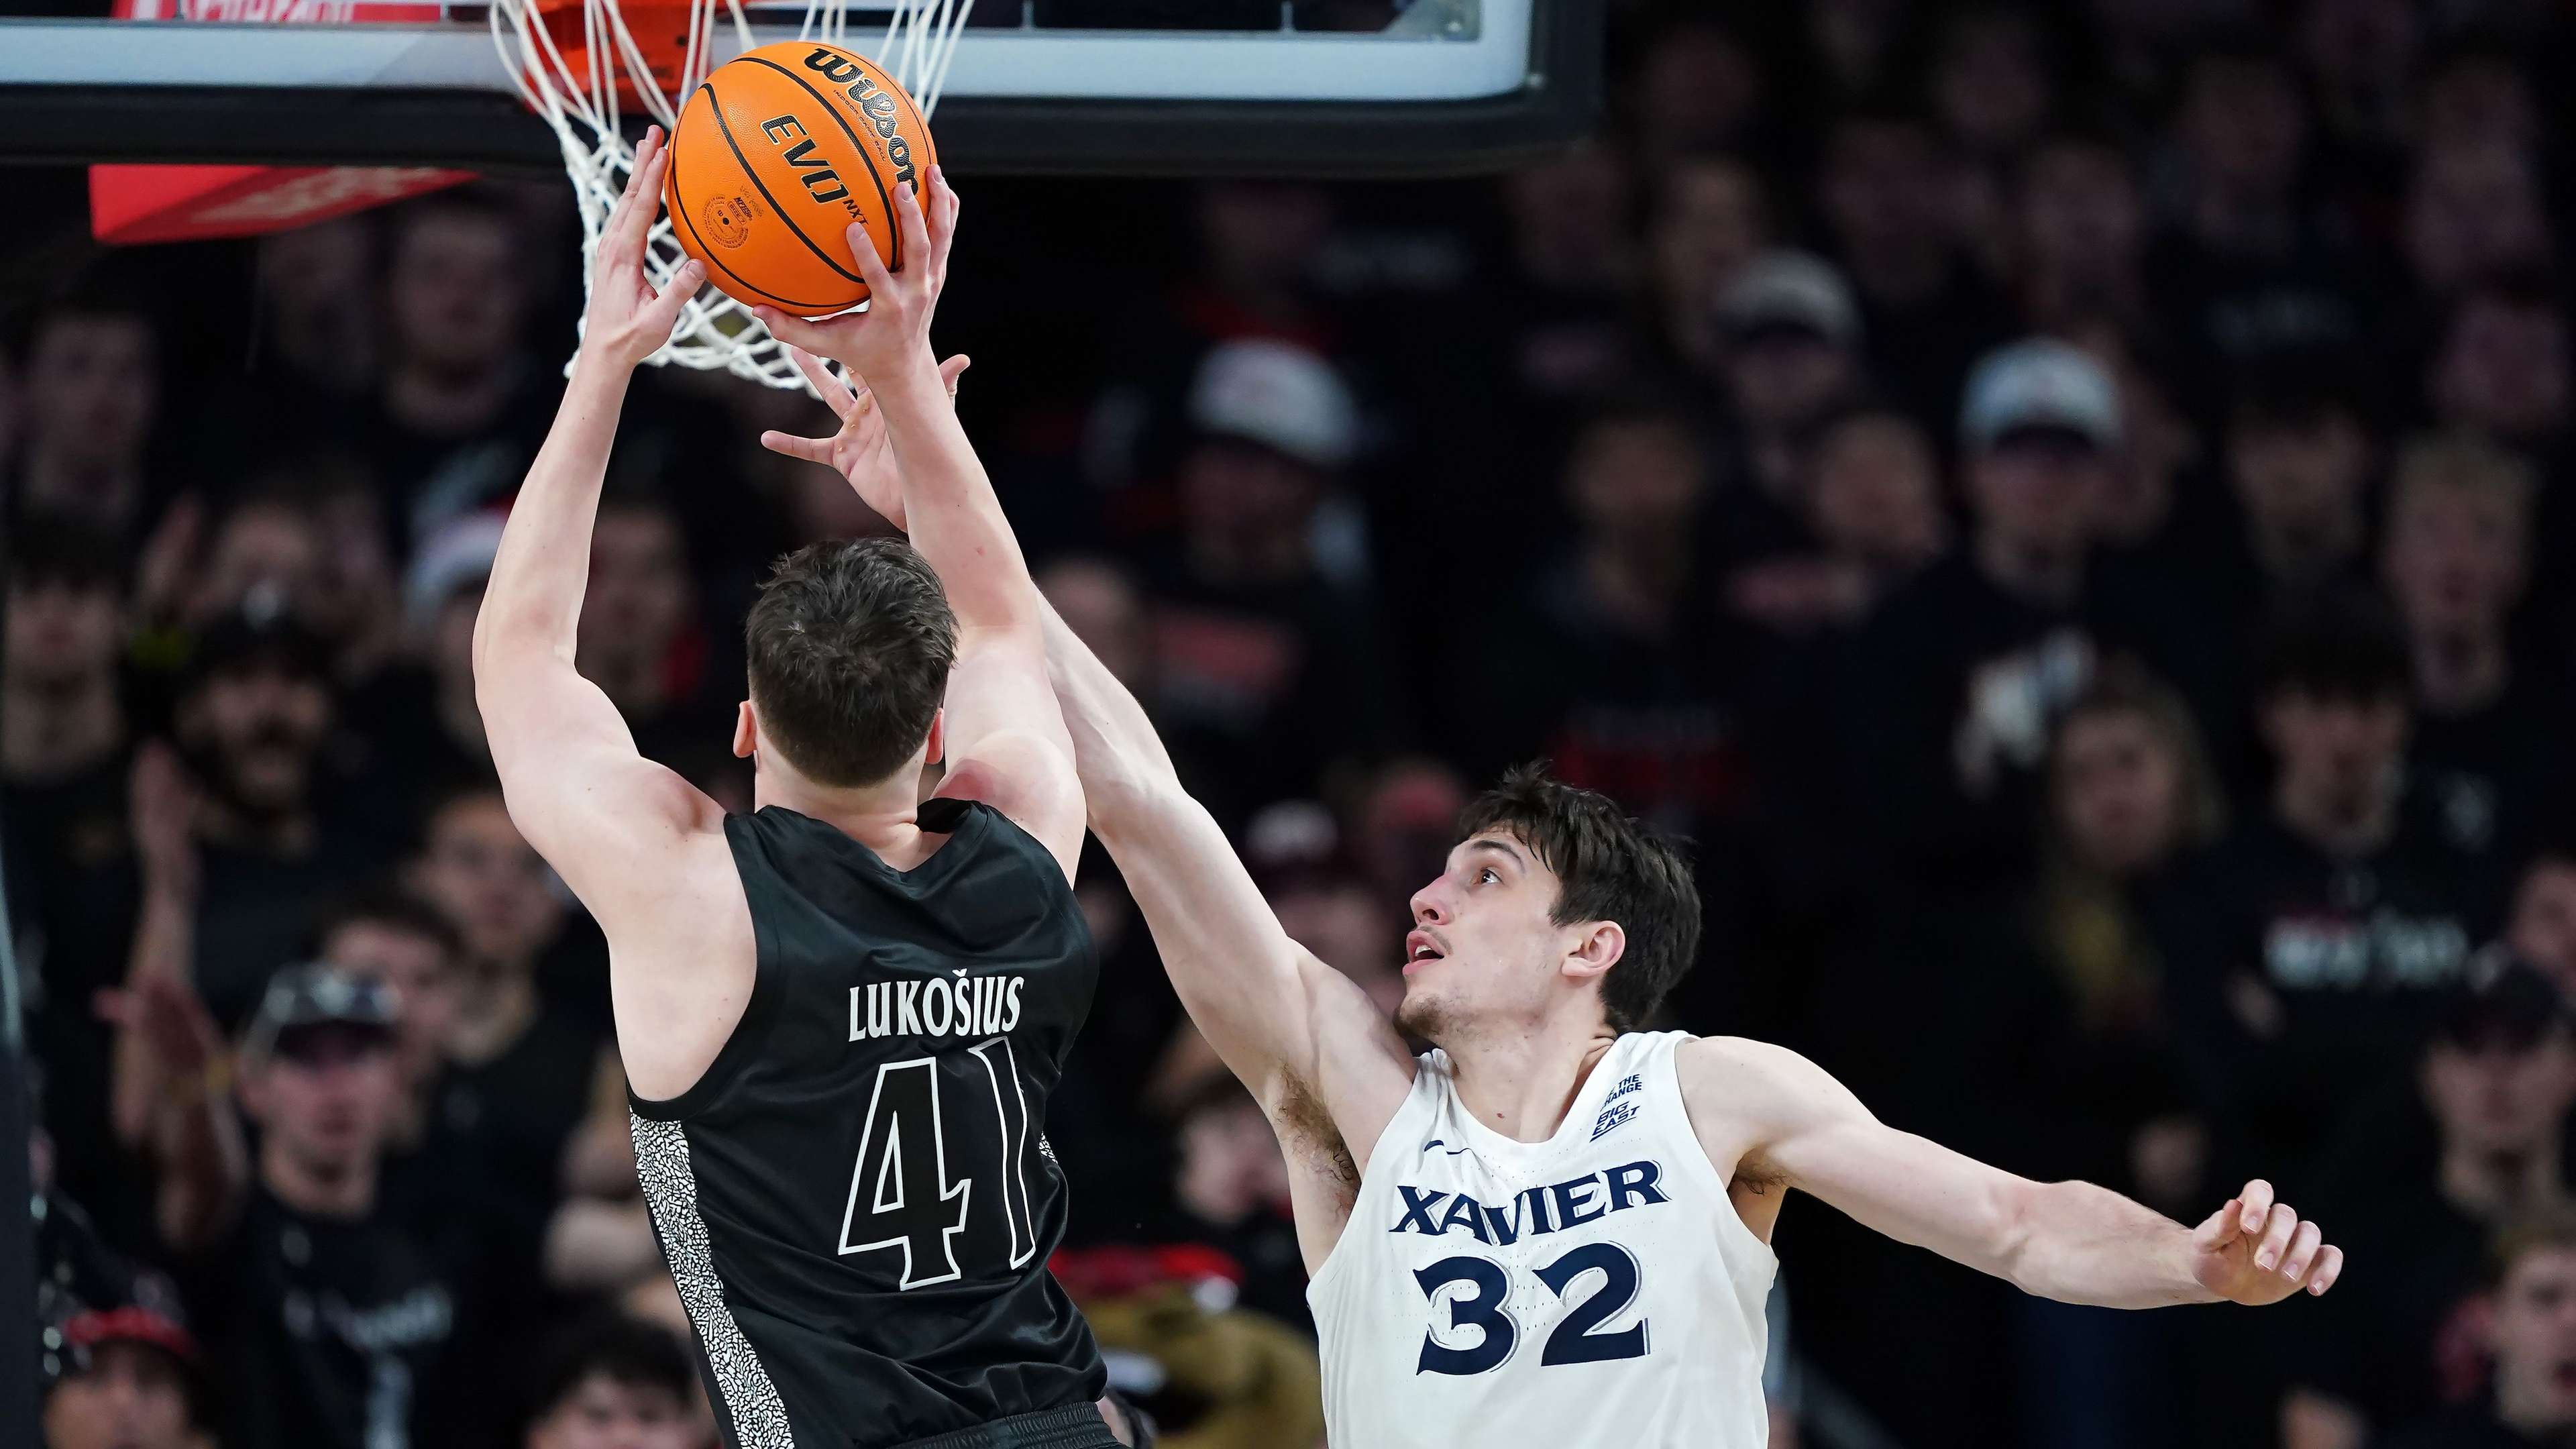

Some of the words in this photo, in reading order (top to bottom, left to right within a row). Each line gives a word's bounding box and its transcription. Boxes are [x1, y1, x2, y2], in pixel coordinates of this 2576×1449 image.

[833, 89, 859, 114] INDOOR
[875, 140, 885, 162] BALL
[760, 114, 850, 204] EVO
[842, 199, 869, 225] NXT
[849, 968, 1024, 1041] LUKOŠIUS
[1597, 1101, 1629, 1125] BIG
[1618, 1073, 1640, 1088] THE
[1592, 1106, 1640, 1136] EAST
[838, 1036, 1036, 1291] 41
[1389, 1160, 1672, 1246] XAVIER
[1413, 1240, 1650, 1375] 32
